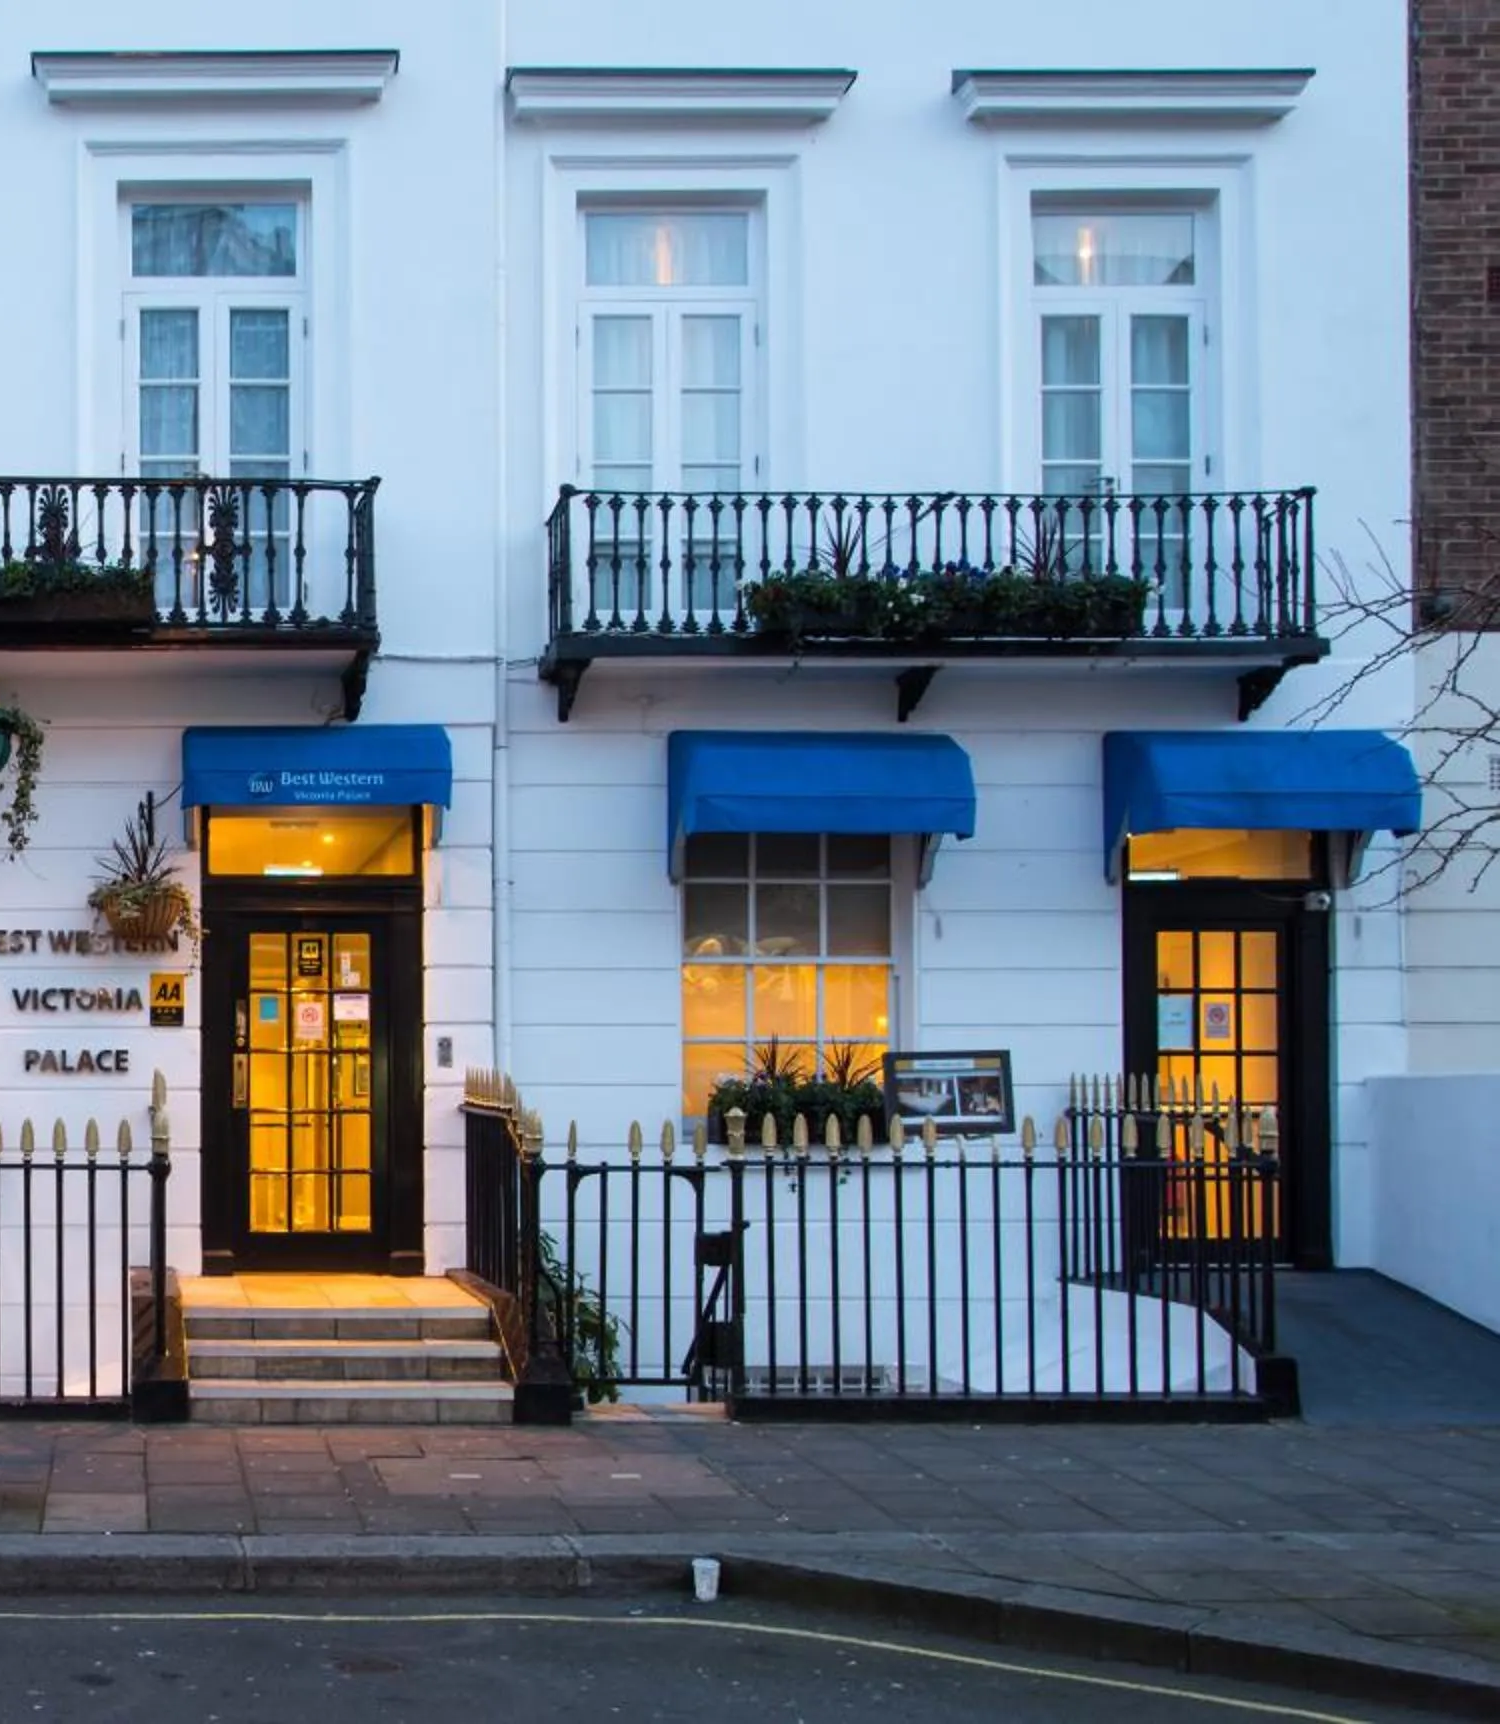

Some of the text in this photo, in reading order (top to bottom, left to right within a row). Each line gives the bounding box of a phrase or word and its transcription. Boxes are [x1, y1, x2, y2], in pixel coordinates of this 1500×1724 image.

[281, 771, 383, 785] Best Western
[12, 988, 143, 1011] VICTORIA
[155, 982, 180, 1001] AA
[25, 1050, 129, 1073] PALACE
